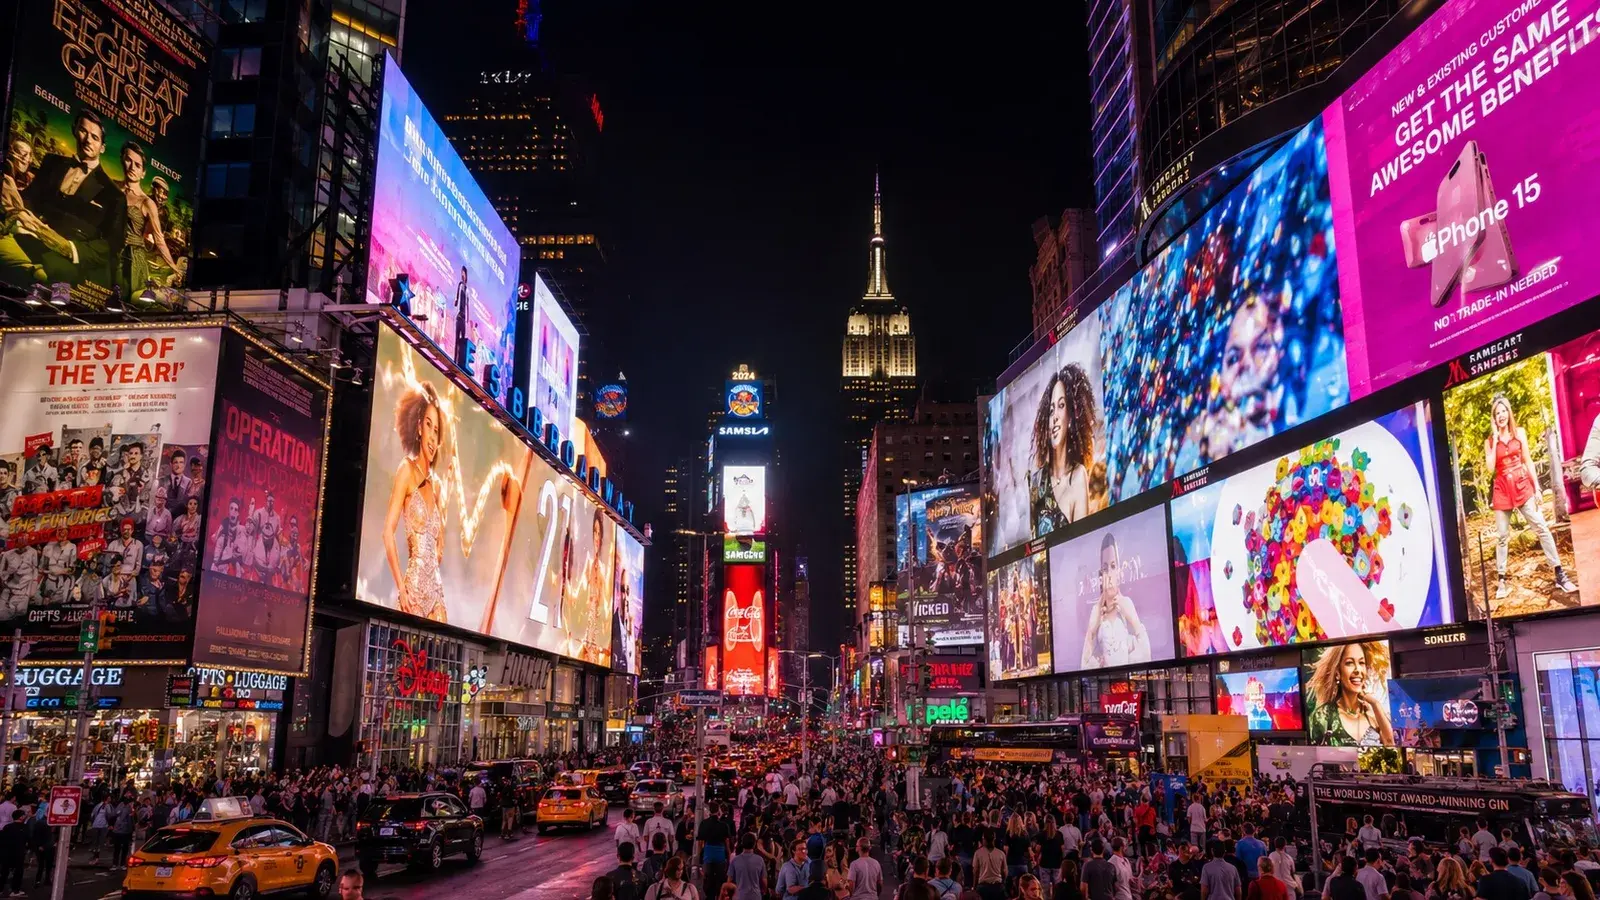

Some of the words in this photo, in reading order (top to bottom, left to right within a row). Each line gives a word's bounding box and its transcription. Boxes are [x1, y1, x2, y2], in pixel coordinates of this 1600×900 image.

[111, 18, 148, 60] THE
[61, 43, 175, 137] GATSBY
[1391, 90, 1415, 118] NEW
[1417, 84, 1426, 97] &
[1427, 42, 1478, 90] EXISTING
[1395, 99, 1436, 147] GET
[1440, 60, 1488, 112] THE
[1493, 0, 1570, 74] SAME
[1370, 102, 1476, 197] AWESOME
[1512, 173, 1541, 210] 15
[1457, 288, 1507, 321] TRADE-IN
[1510, 264, 1558, 295] NEEDED
[137, 338, 175, 359] OF
[46, 364, 96, 385] THE
[732, 371, 755, 380] 2024
[226, 405, 316, 477] OPERATION
[234, 671, 288, 691] LUGGAGE
[1315, 787, 1332, 797] THE
[1334, 788, 1371, 800] WORLD'S
[1372, 791, 1398, 802] MOST
[1401, 794, 1486, 810] AWARD-WINNING
[1488, 799, 1510, 811] GIN
